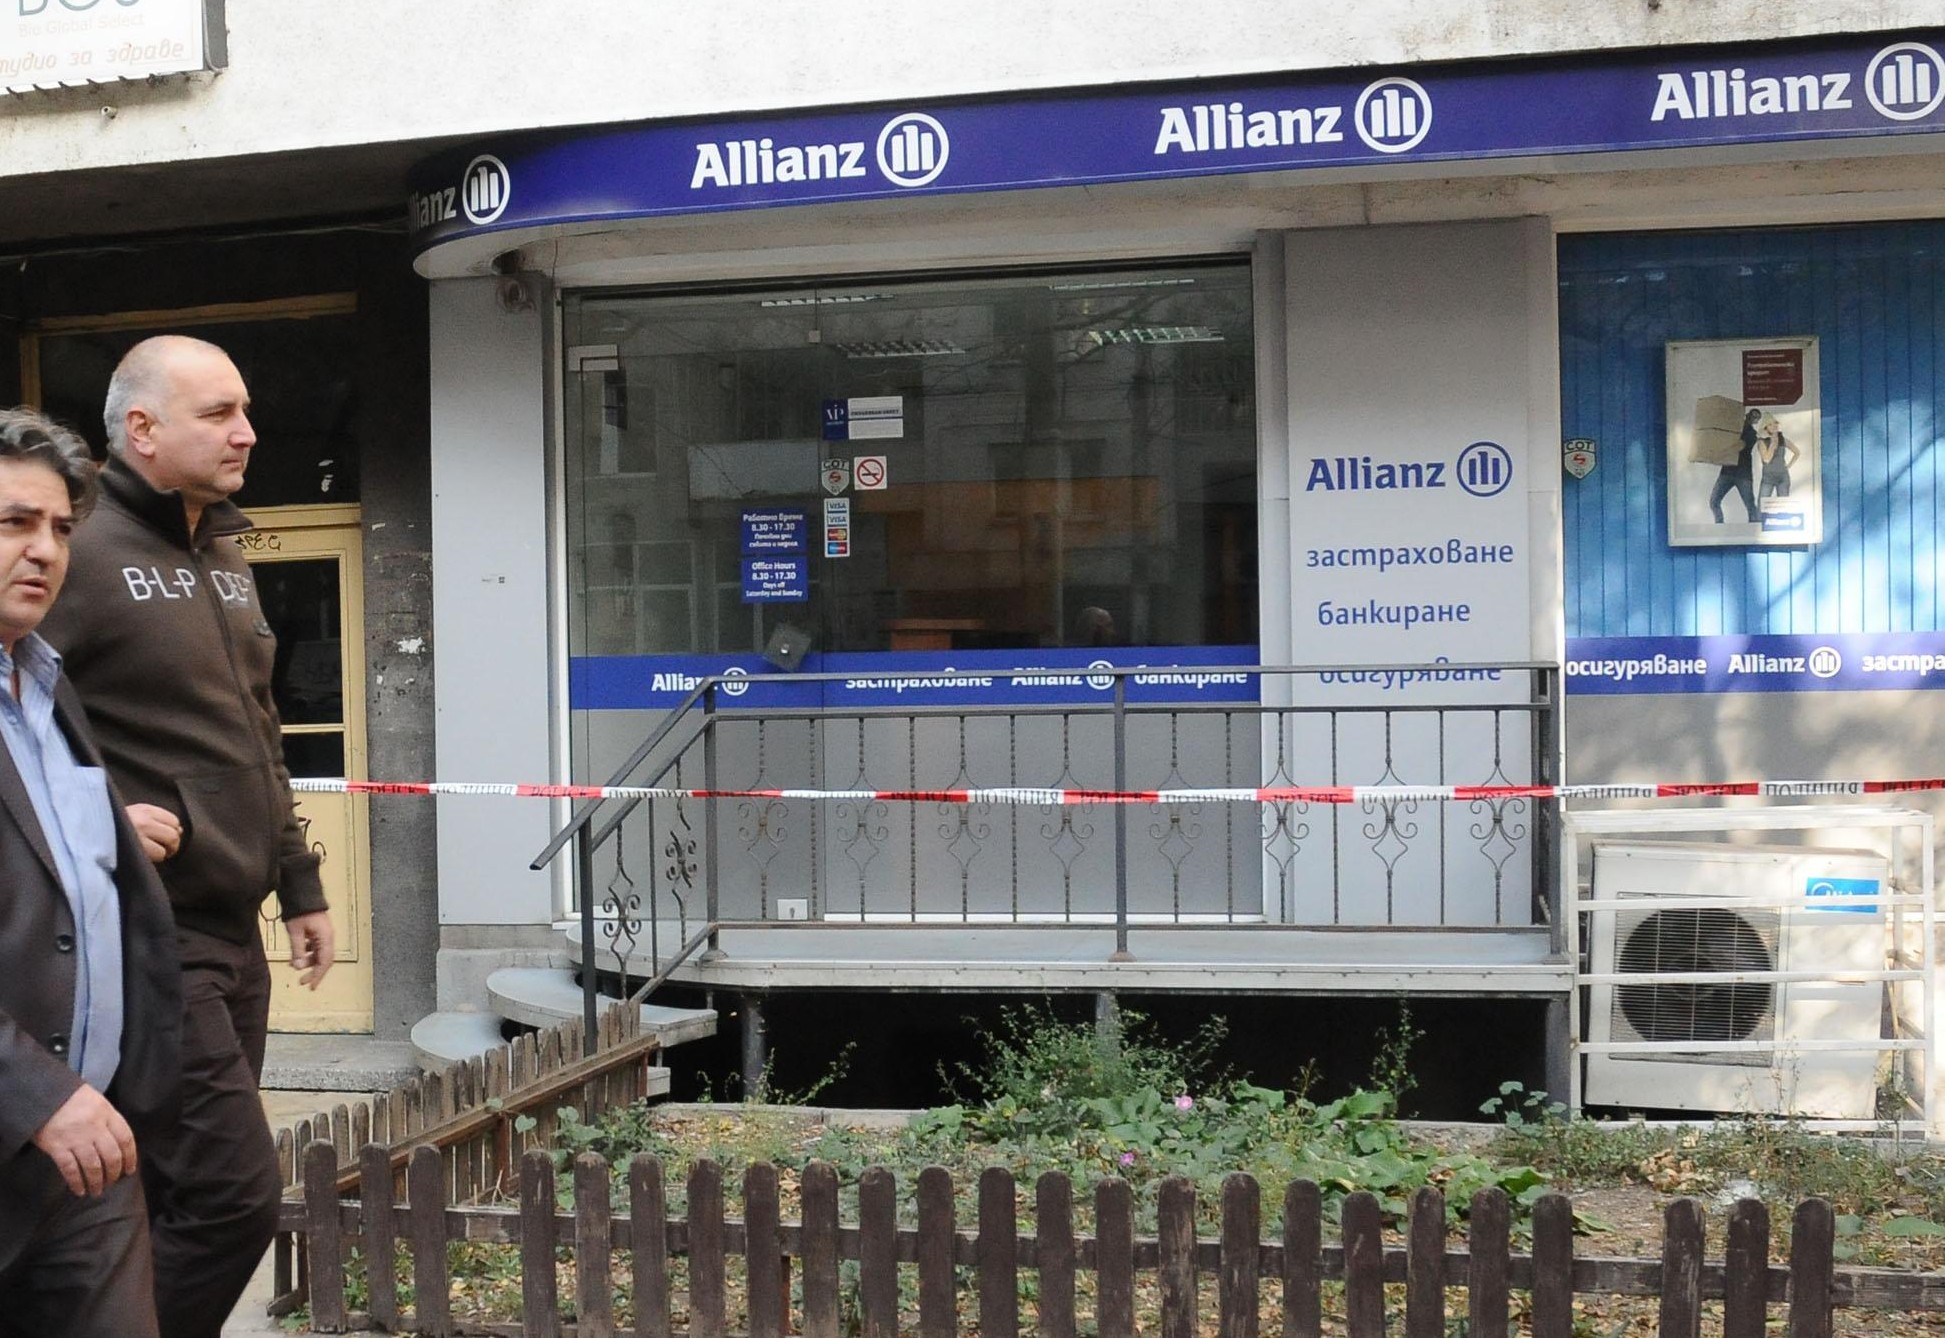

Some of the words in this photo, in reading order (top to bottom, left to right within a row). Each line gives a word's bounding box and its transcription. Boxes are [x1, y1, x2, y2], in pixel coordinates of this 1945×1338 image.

[1651, 69, 1852, 122] Allianz
[1154, 104, 1343, 154] Allianz
[691, 139, 866, 189] Allianz
[1306, 456, 1446, 491] Allianz
[752, 562, 772, 570] Office
[1306, 539, 1514, 572] застраховане
[752, 572, 769, 580] 8.30
[775, 571, 796, 579] 17.30
[1318, 600, 1470, 630] банкиране
[1566, 654, 1707, 681] осигуряване
[1728, 654, 1806, 674] Allianz
[651, 673, 719, 692] Allia
